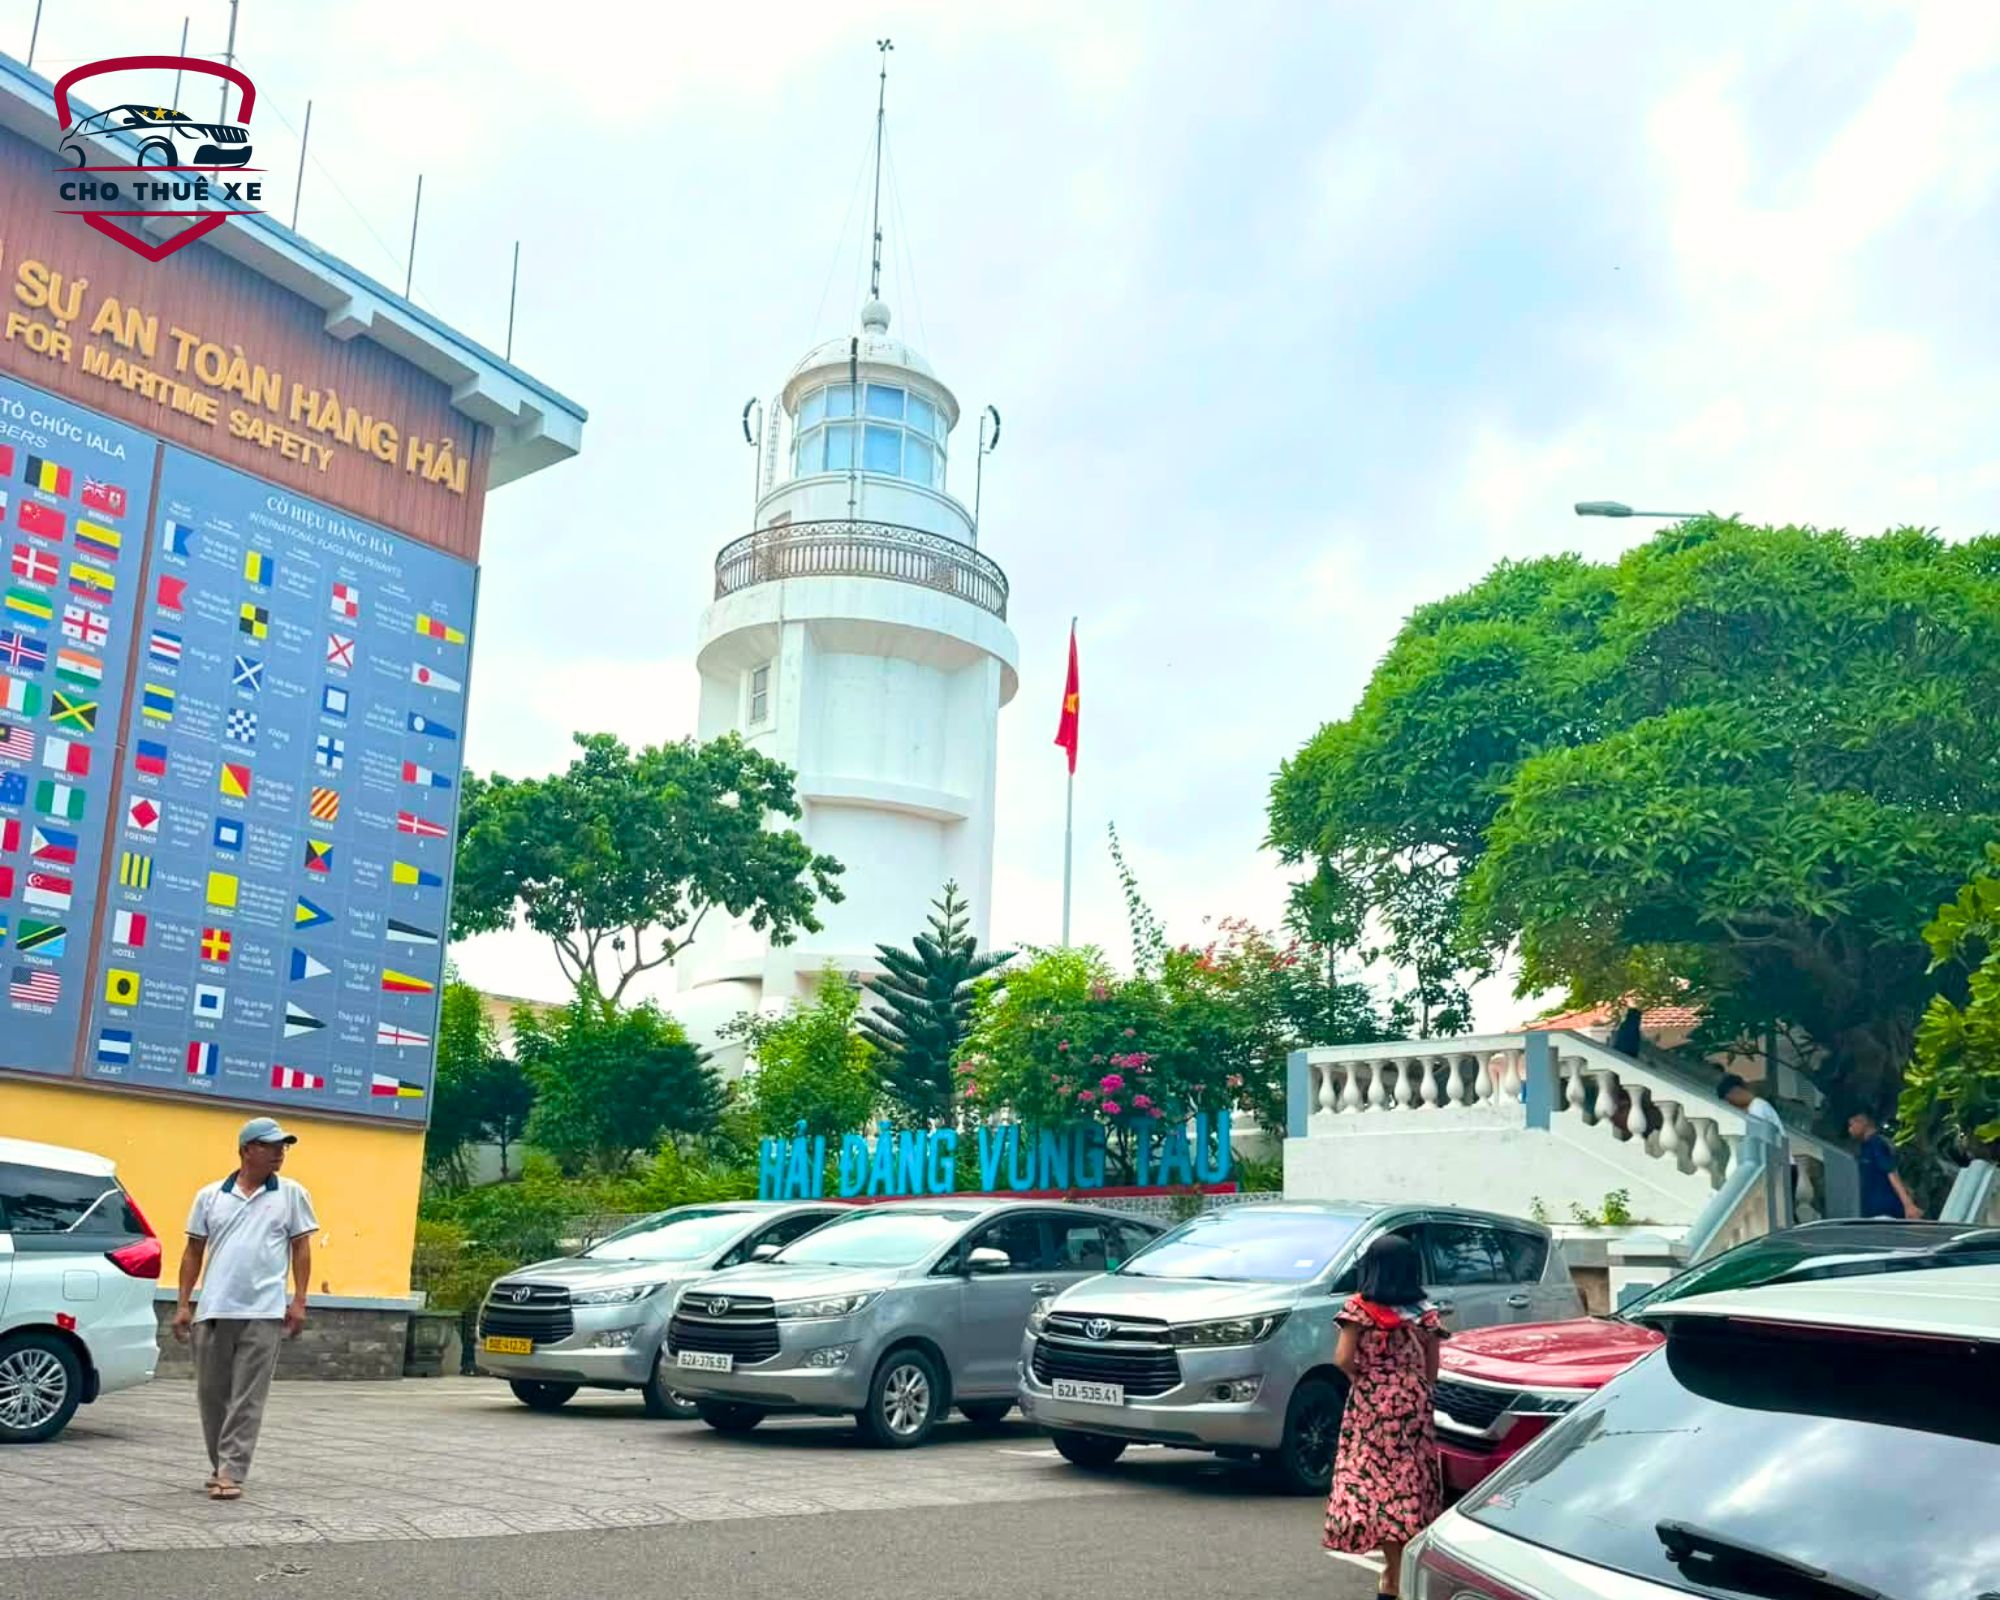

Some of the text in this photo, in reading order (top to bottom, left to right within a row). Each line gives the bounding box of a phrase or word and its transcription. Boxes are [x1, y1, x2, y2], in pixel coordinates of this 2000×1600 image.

[5, 311, 334, 472] FOR MARITIME SAFETY
[15, 259, 468, 496] SỰ AN TOÀN HÀNG HẢI
[30, 410, 83, 442] CHỨC
[86, 430, 126, 461] IALA
[758, 1119, 827, 1200] HẢI
[838, 1120, 957, 1198] ĐĂNG
[1057, 1384, 1118, 1403] 62A-535.41
